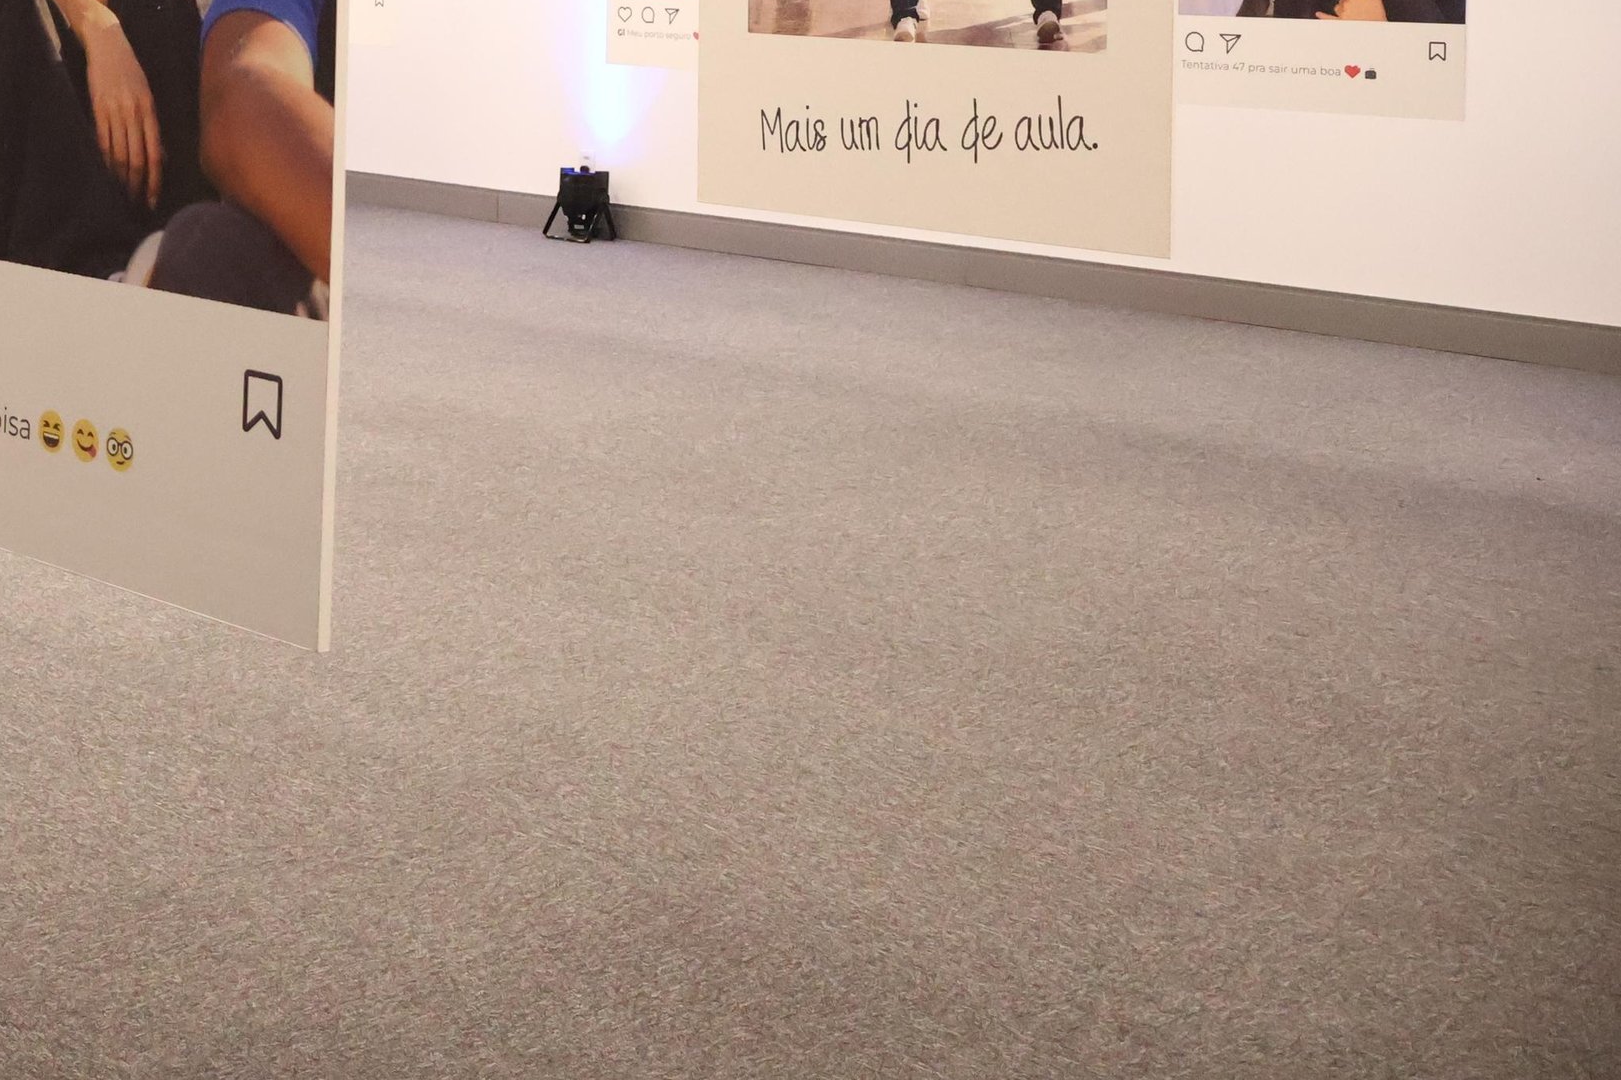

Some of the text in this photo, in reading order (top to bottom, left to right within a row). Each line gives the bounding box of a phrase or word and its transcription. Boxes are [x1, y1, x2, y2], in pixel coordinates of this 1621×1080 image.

[1181, 60, 1341, 76] Tentativa 47 pra sair uma boa
[760, 95, 1099, 163] Mais um dia de aula.
